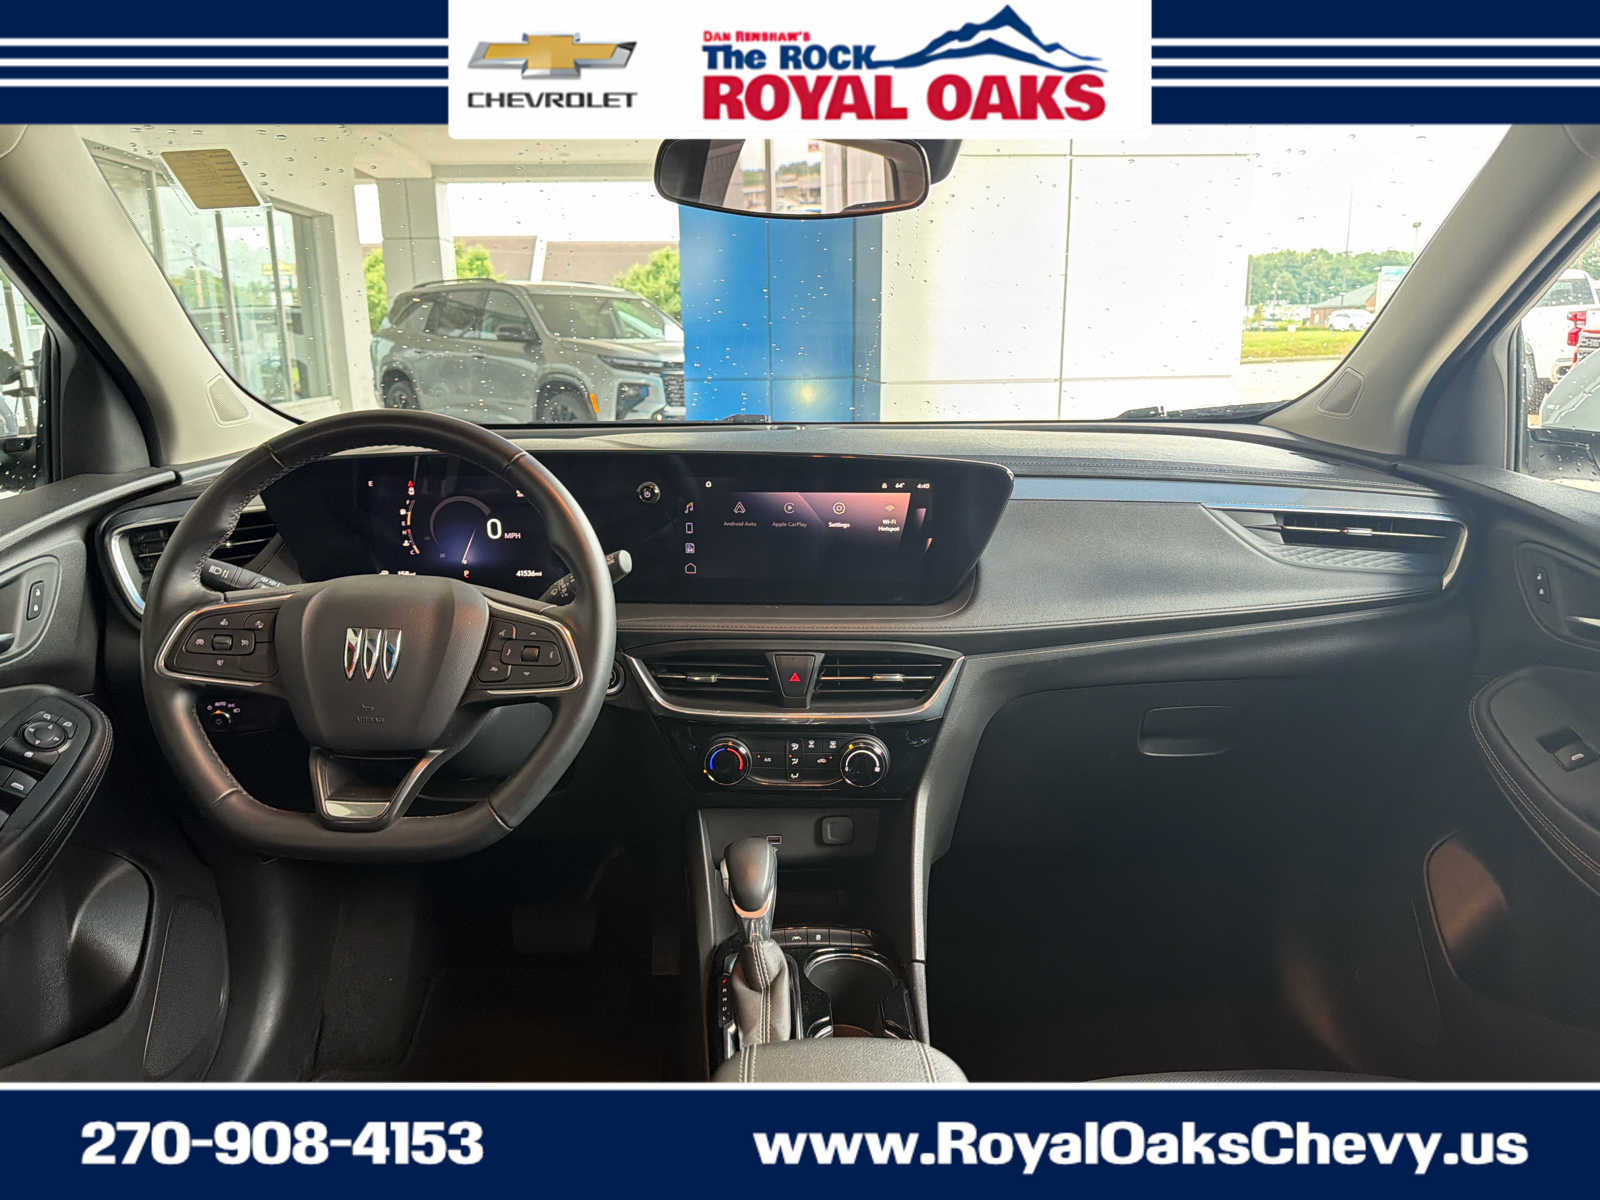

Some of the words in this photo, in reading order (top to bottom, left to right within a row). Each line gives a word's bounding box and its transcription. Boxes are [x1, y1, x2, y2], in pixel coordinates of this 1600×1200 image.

[486, 518, 503, 540] 0
[504, 531, 522, 540] MPH
[772, 521, 787, 529] Apple
[788, 521, 808, 529] CarPlay
[827, 522, 851, 530] Settings
